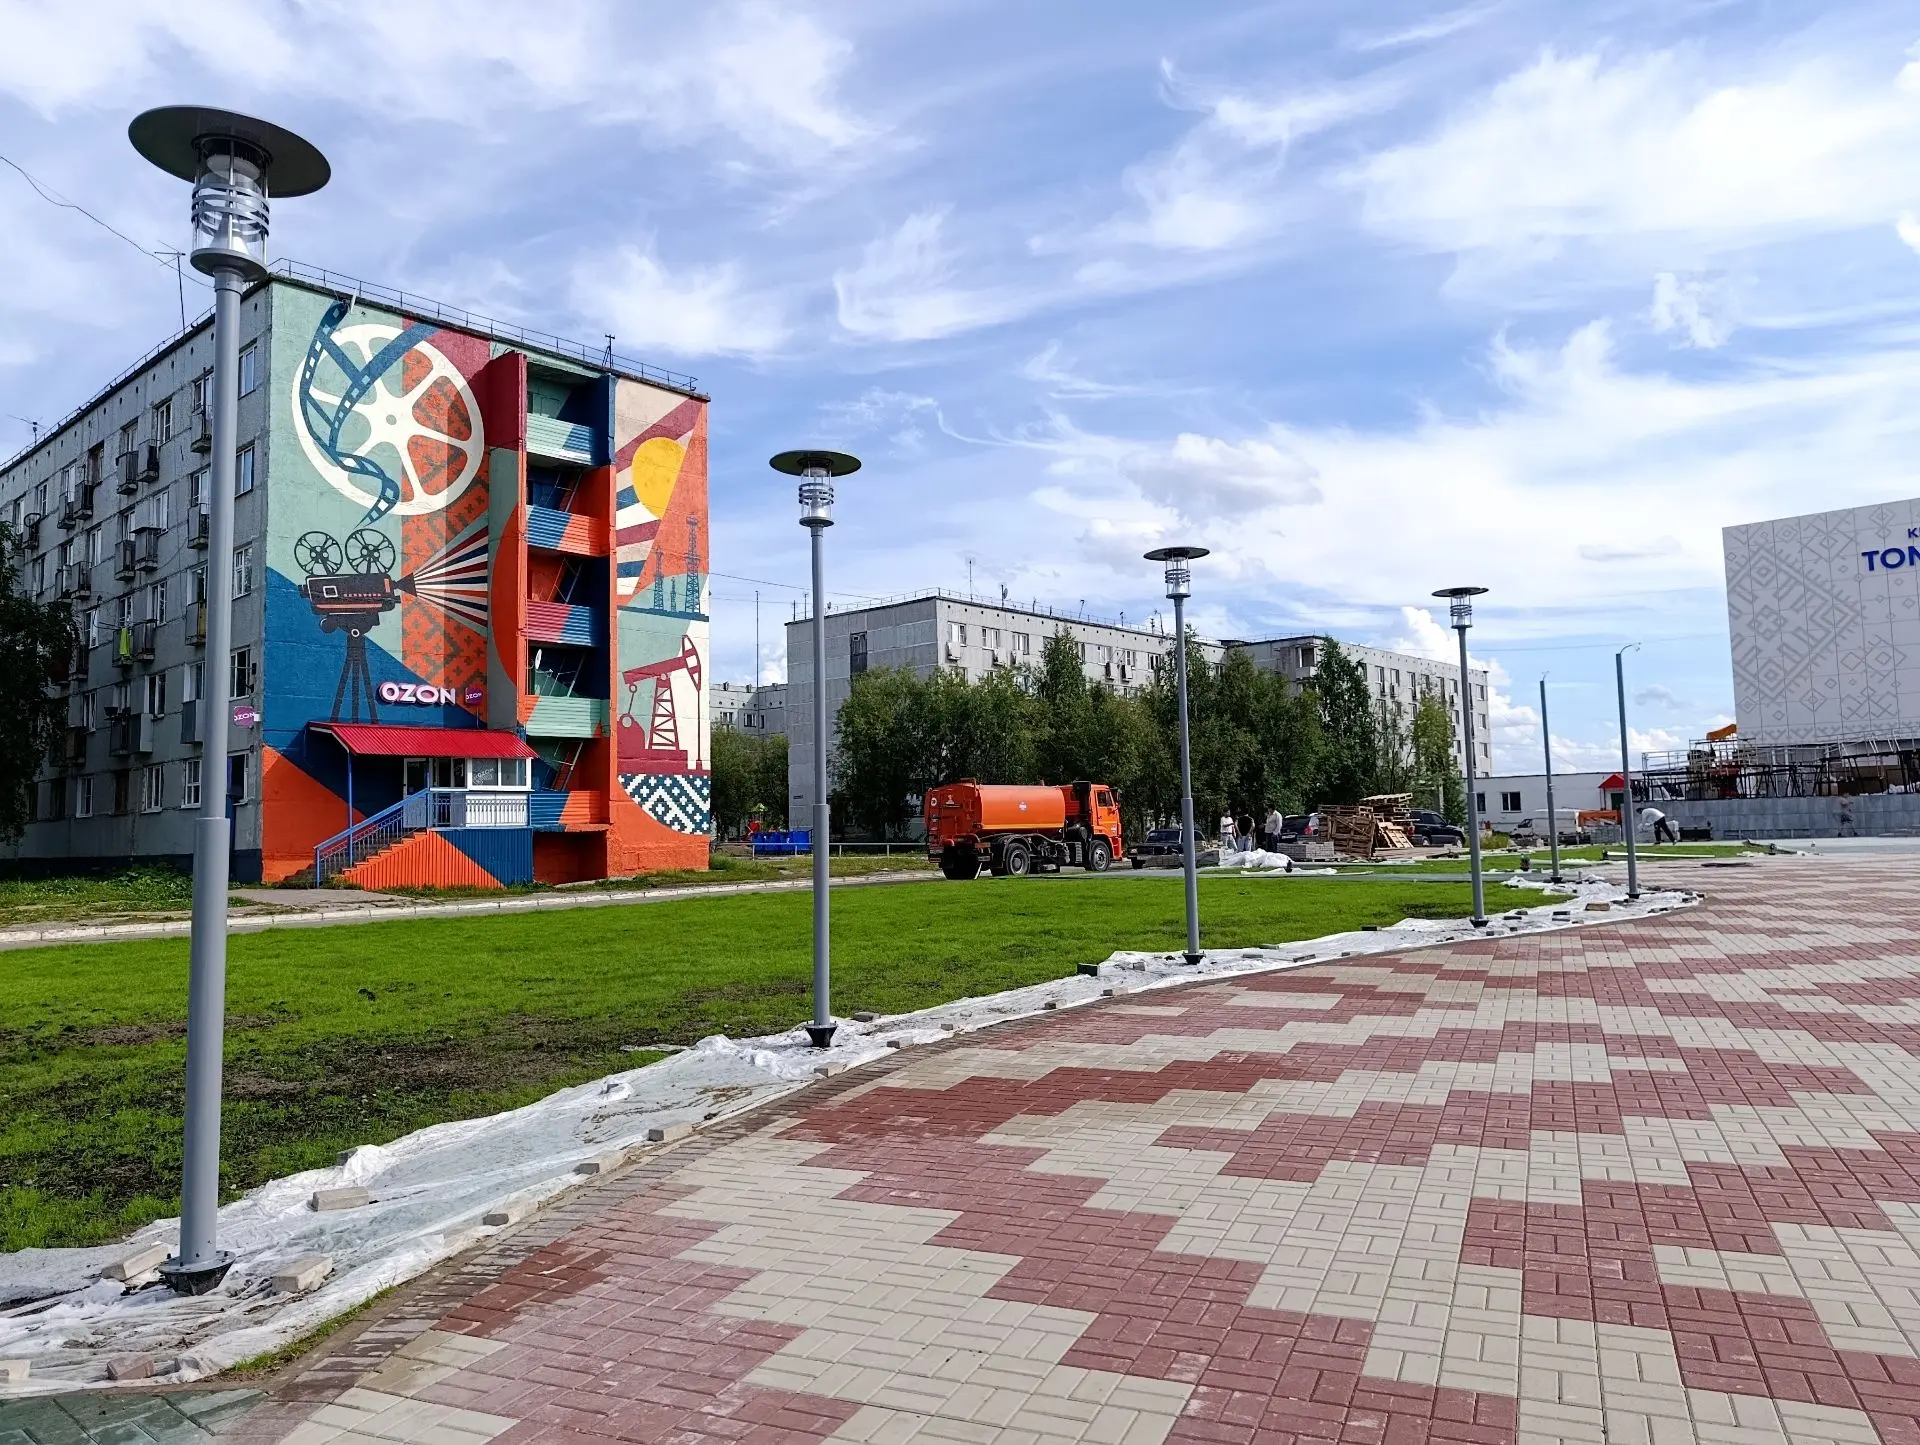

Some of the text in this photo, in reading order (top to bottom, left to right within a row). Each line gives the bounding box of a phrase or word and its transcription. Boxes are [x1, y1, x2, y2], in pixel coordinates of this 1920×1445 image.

[379, 682, 456, 705] OZON
[465, 691, 482, 700] OZON
[234, 712, 255, 721] OZON
